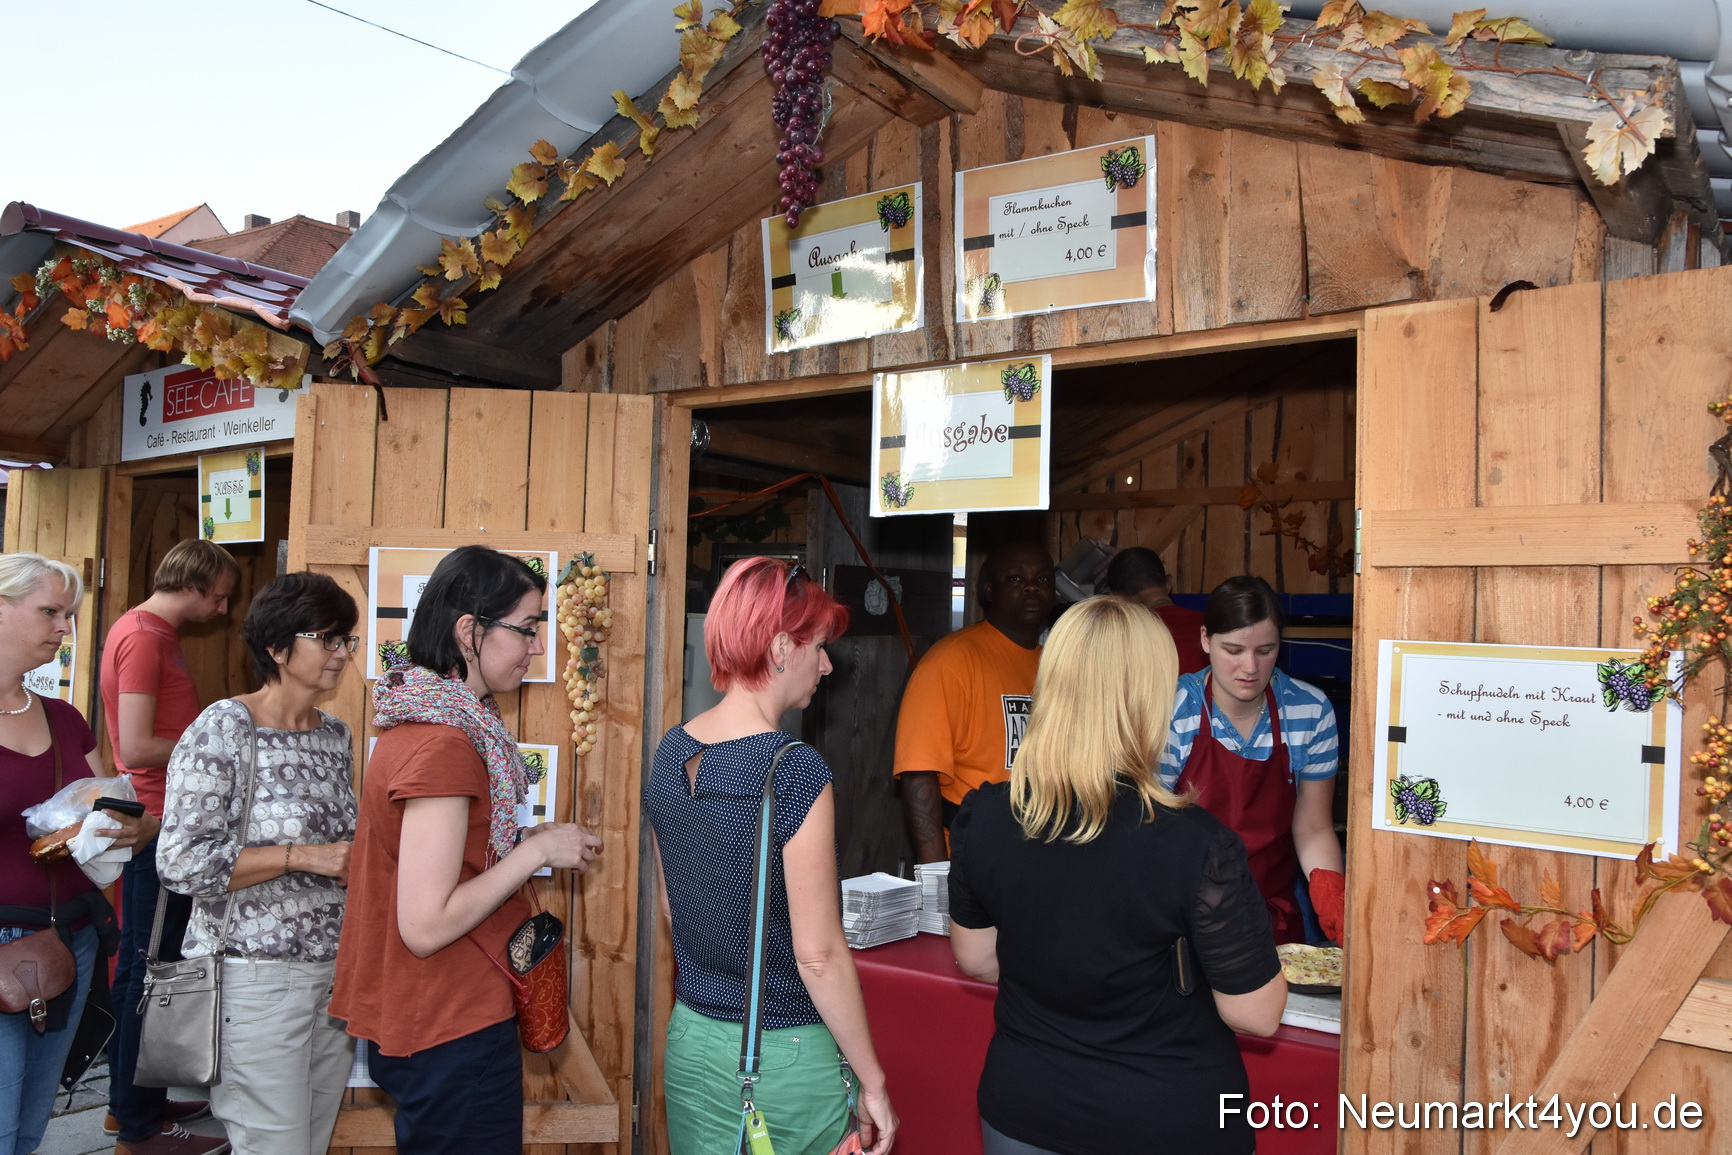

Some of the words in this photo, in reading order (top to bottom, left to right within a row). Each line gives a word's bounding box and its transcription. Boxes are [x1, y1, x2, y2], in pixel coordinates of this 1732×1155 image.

[1003, 197, 1073, 217] Flammkuchen
[998, 227, 1016, 240] mit
[1029, 220, 1053, 236] ohne
[1056, 214, 1091, 233] Speck
[1064, 246, 1093, 265] 4,00
[1096, 243, 1107, 258] €
[146, 433, 166, 449] Café
[172, 426, 216, 445] Restaurant
[223, 416, 276, 436] Weinkeller
[28, 671, 56, 691] Kasse
[1438, 680, 1521, 703] Schupfnudeln
[1525, 690, 1546, 701] mit
[1551, 686, 1597, 704] Kraut
[1446, 710, 1466, 721] mit
[1470, 711, 1493, 723] und
[1496, 712, 1525, 725] ohne
[1529, 710, 1572, 731] Speck
[1563, 794, 1594, 810] 4,00
[1598, 798, 1609, 811] €
